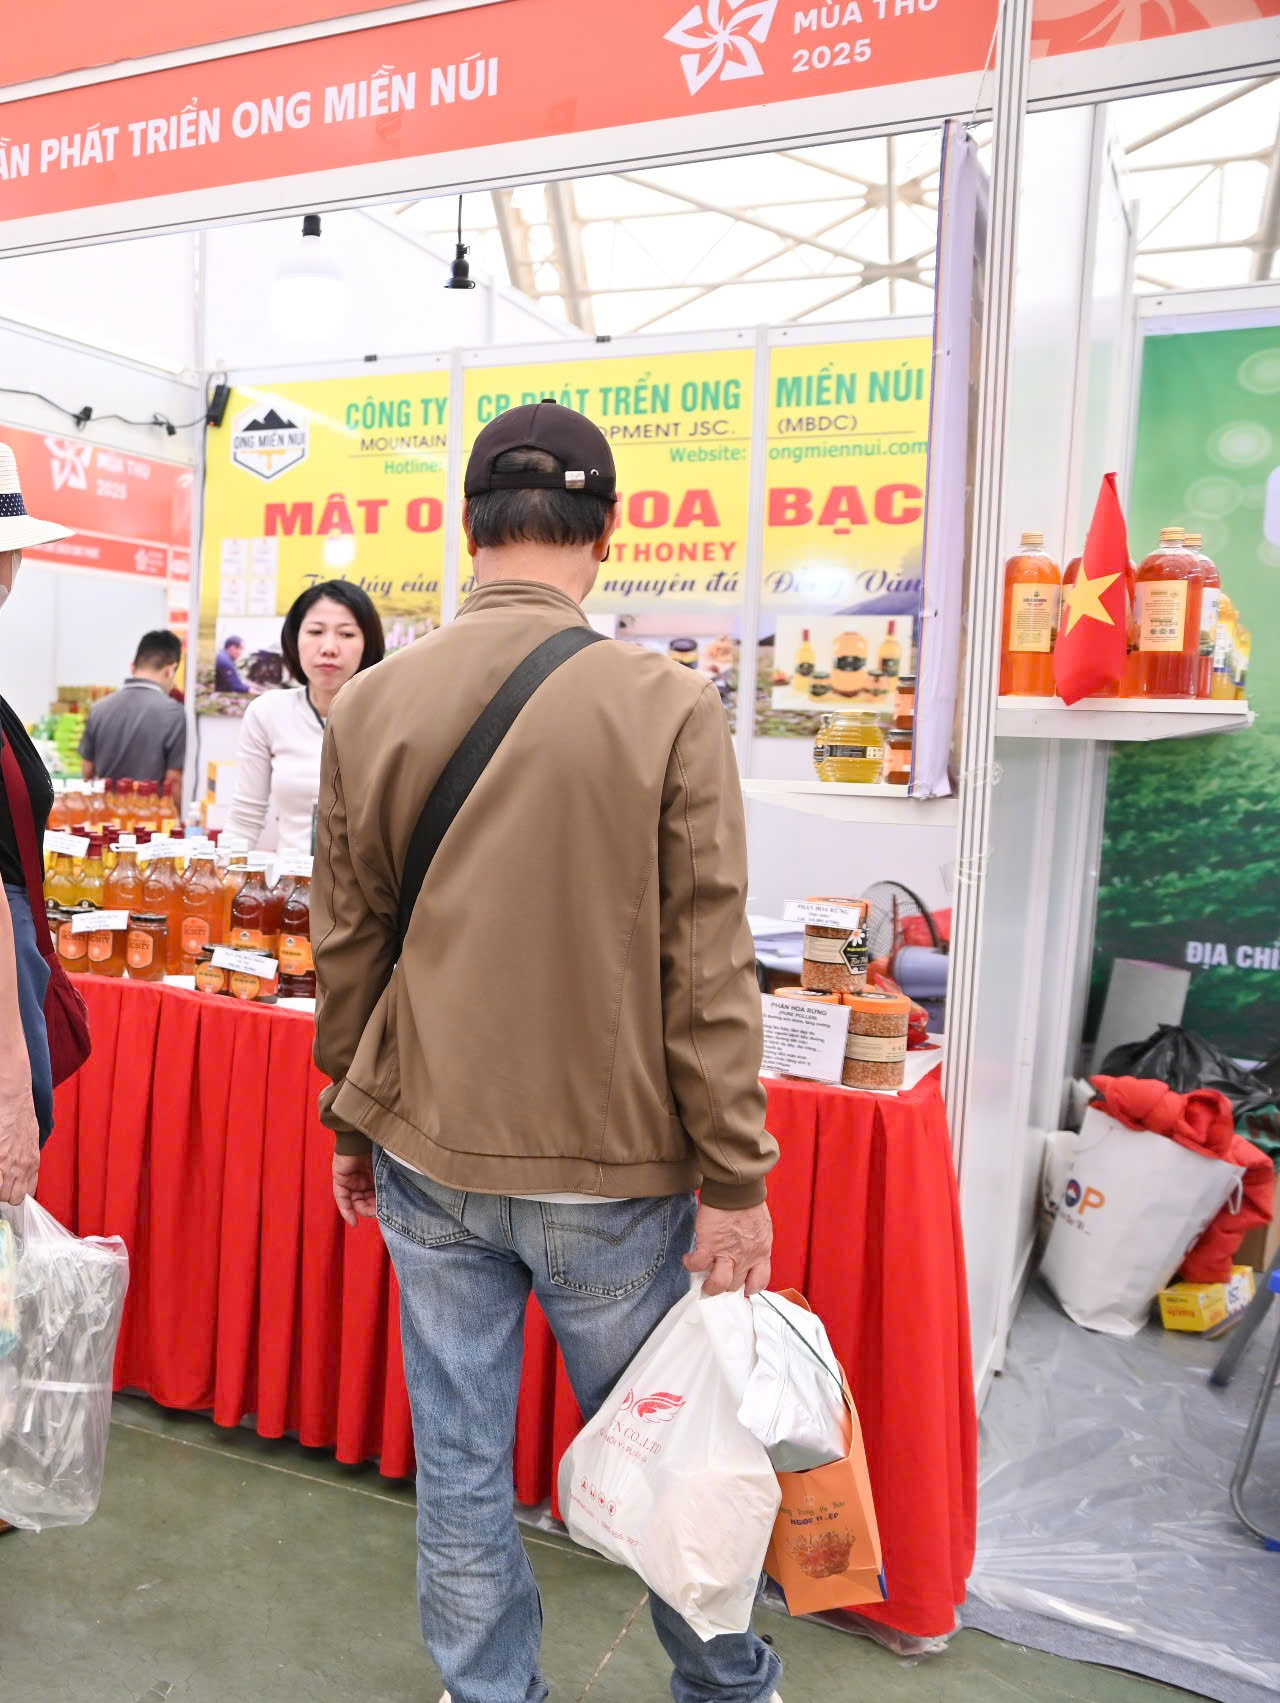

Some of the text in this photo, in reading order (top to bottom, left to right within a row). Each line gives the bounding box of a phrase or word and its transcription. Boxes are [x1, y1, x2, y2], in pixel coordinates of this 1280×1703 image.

[792, 38, 872, 73] 2025
[40, 122, 120, 173] PHÁT
[128, 97, 220, 157] TRIỂN
[232, 91, 311, 138] ONG
[323, 63, 416, 124] MIỀN
[430, 51, 498, 106] NÚI
[346, 396, 411, 430] CÔNG
[421, 397, 448, 426] TY
[681, 378, 741, 412] ONG
[868, 361, 924, 403] NÚI
[361, 434, 447, 451] MOUNTAIN
[688, 420, 735, 436] JSC.
[777, 415, 857, 434] (MBDC)
[384, 439, 929, 475] Hotline: Website: ongmiennui.com
[768, 483, 924, 535] BẠC
[633, 541, 737, 563] HONEY
[604, 572, 694, 596] nguyên
[61, 933, 86, 941] HONEY
[184, 928, 207, 936] HONEY
[1186, 941, 1229, 970] ĐỊA
